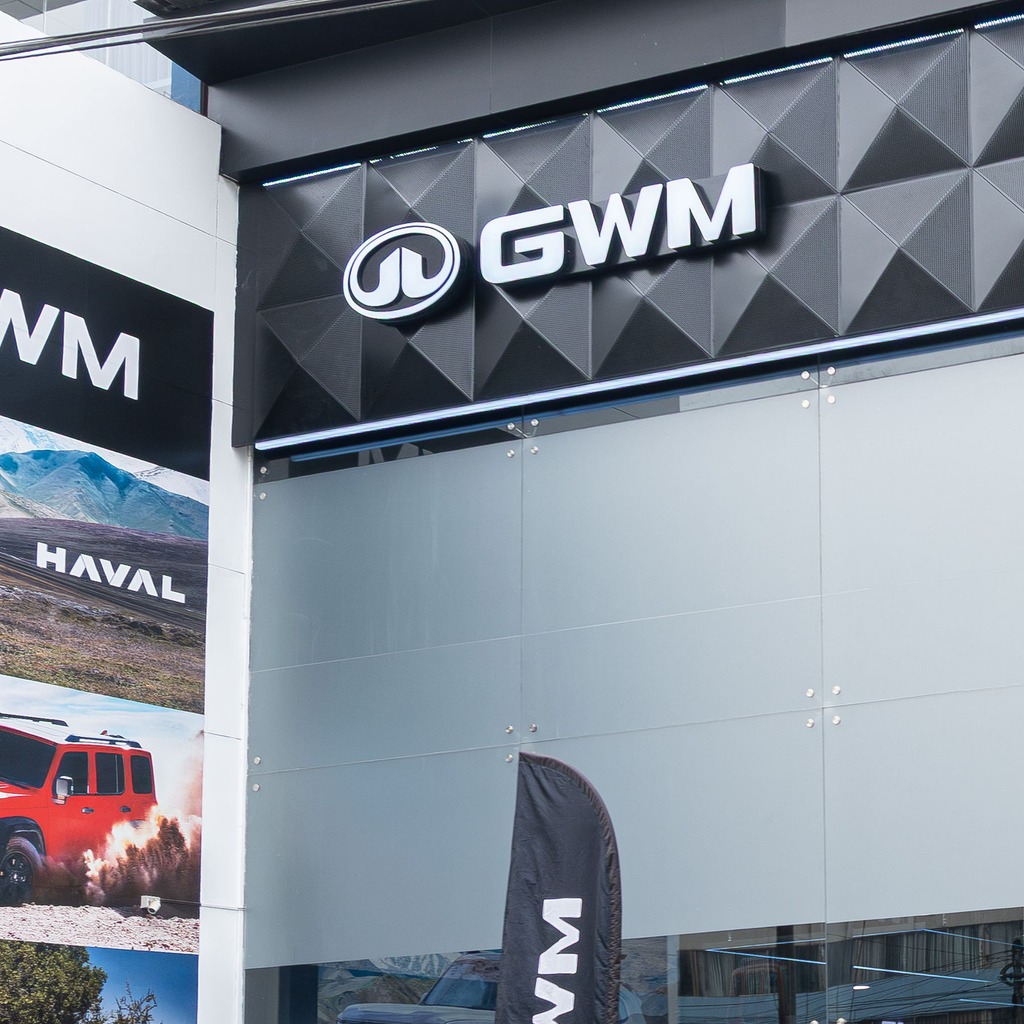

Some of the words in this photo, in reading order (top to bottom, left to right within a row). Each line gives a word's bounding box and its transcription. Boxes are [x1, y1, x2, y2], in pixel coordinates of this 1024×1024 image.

[480, 162, 757, 284] GWM
[0, 288, 140, 401] WM
[36, 541, 187, 604] HAVAL
